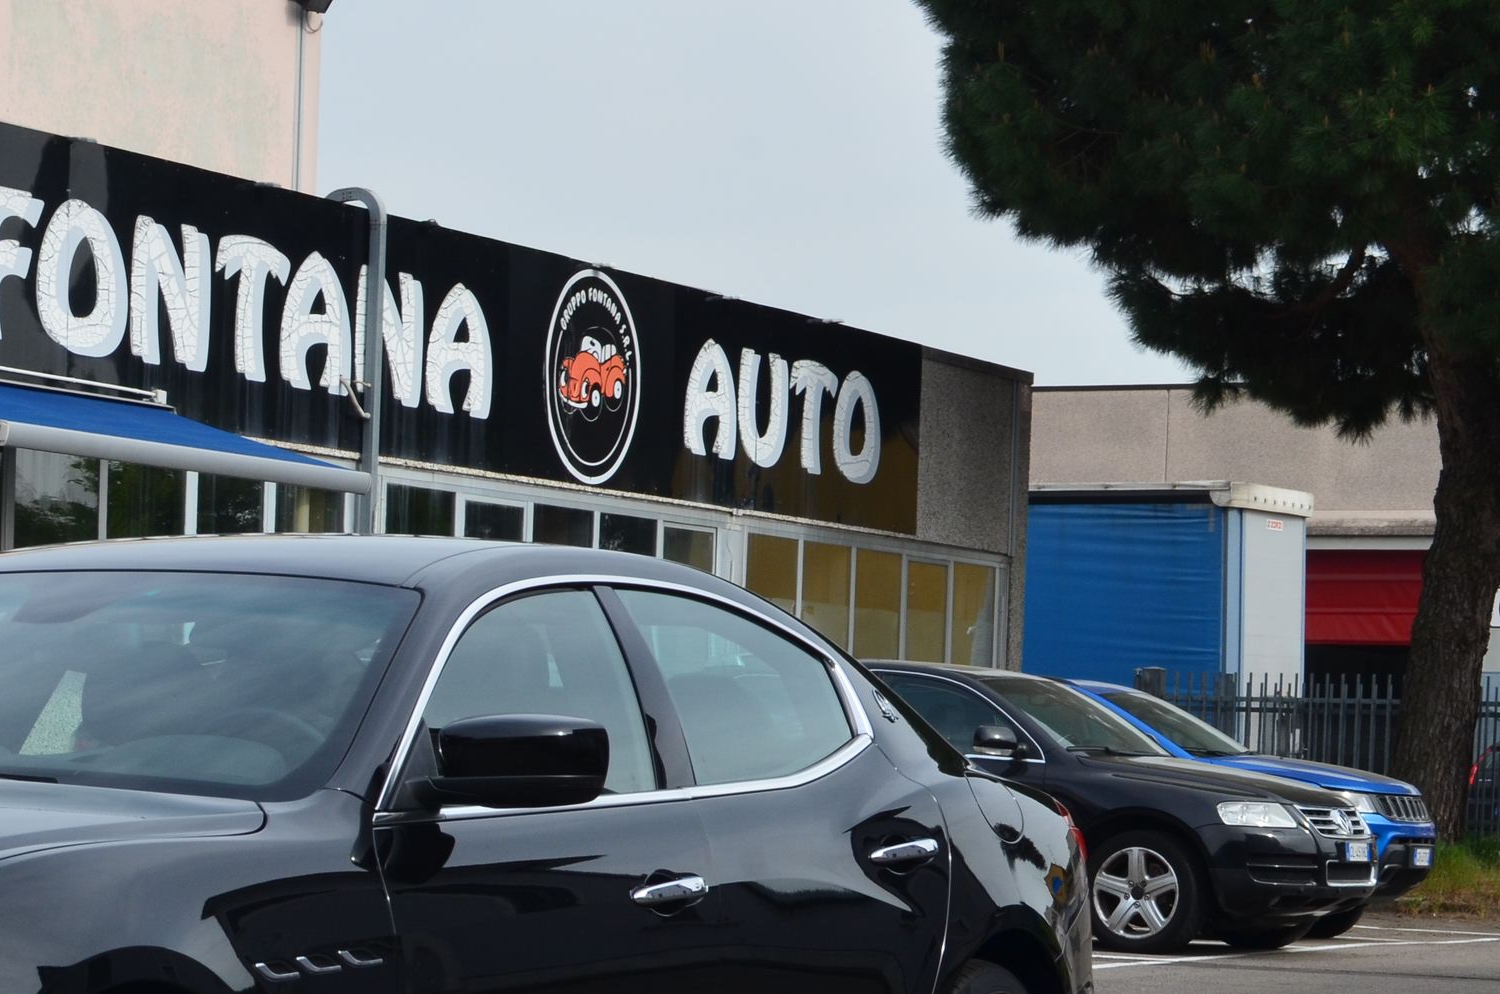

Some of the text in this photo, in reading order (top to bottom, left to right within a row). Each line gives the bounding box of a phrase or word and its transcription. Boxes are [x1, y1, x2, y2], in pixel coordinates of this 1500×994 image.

[560, 290, 587, 330] GRUPPO
[588, 287, 621, 325] FONTANA
[684, 338, 881, 485] AUTO
